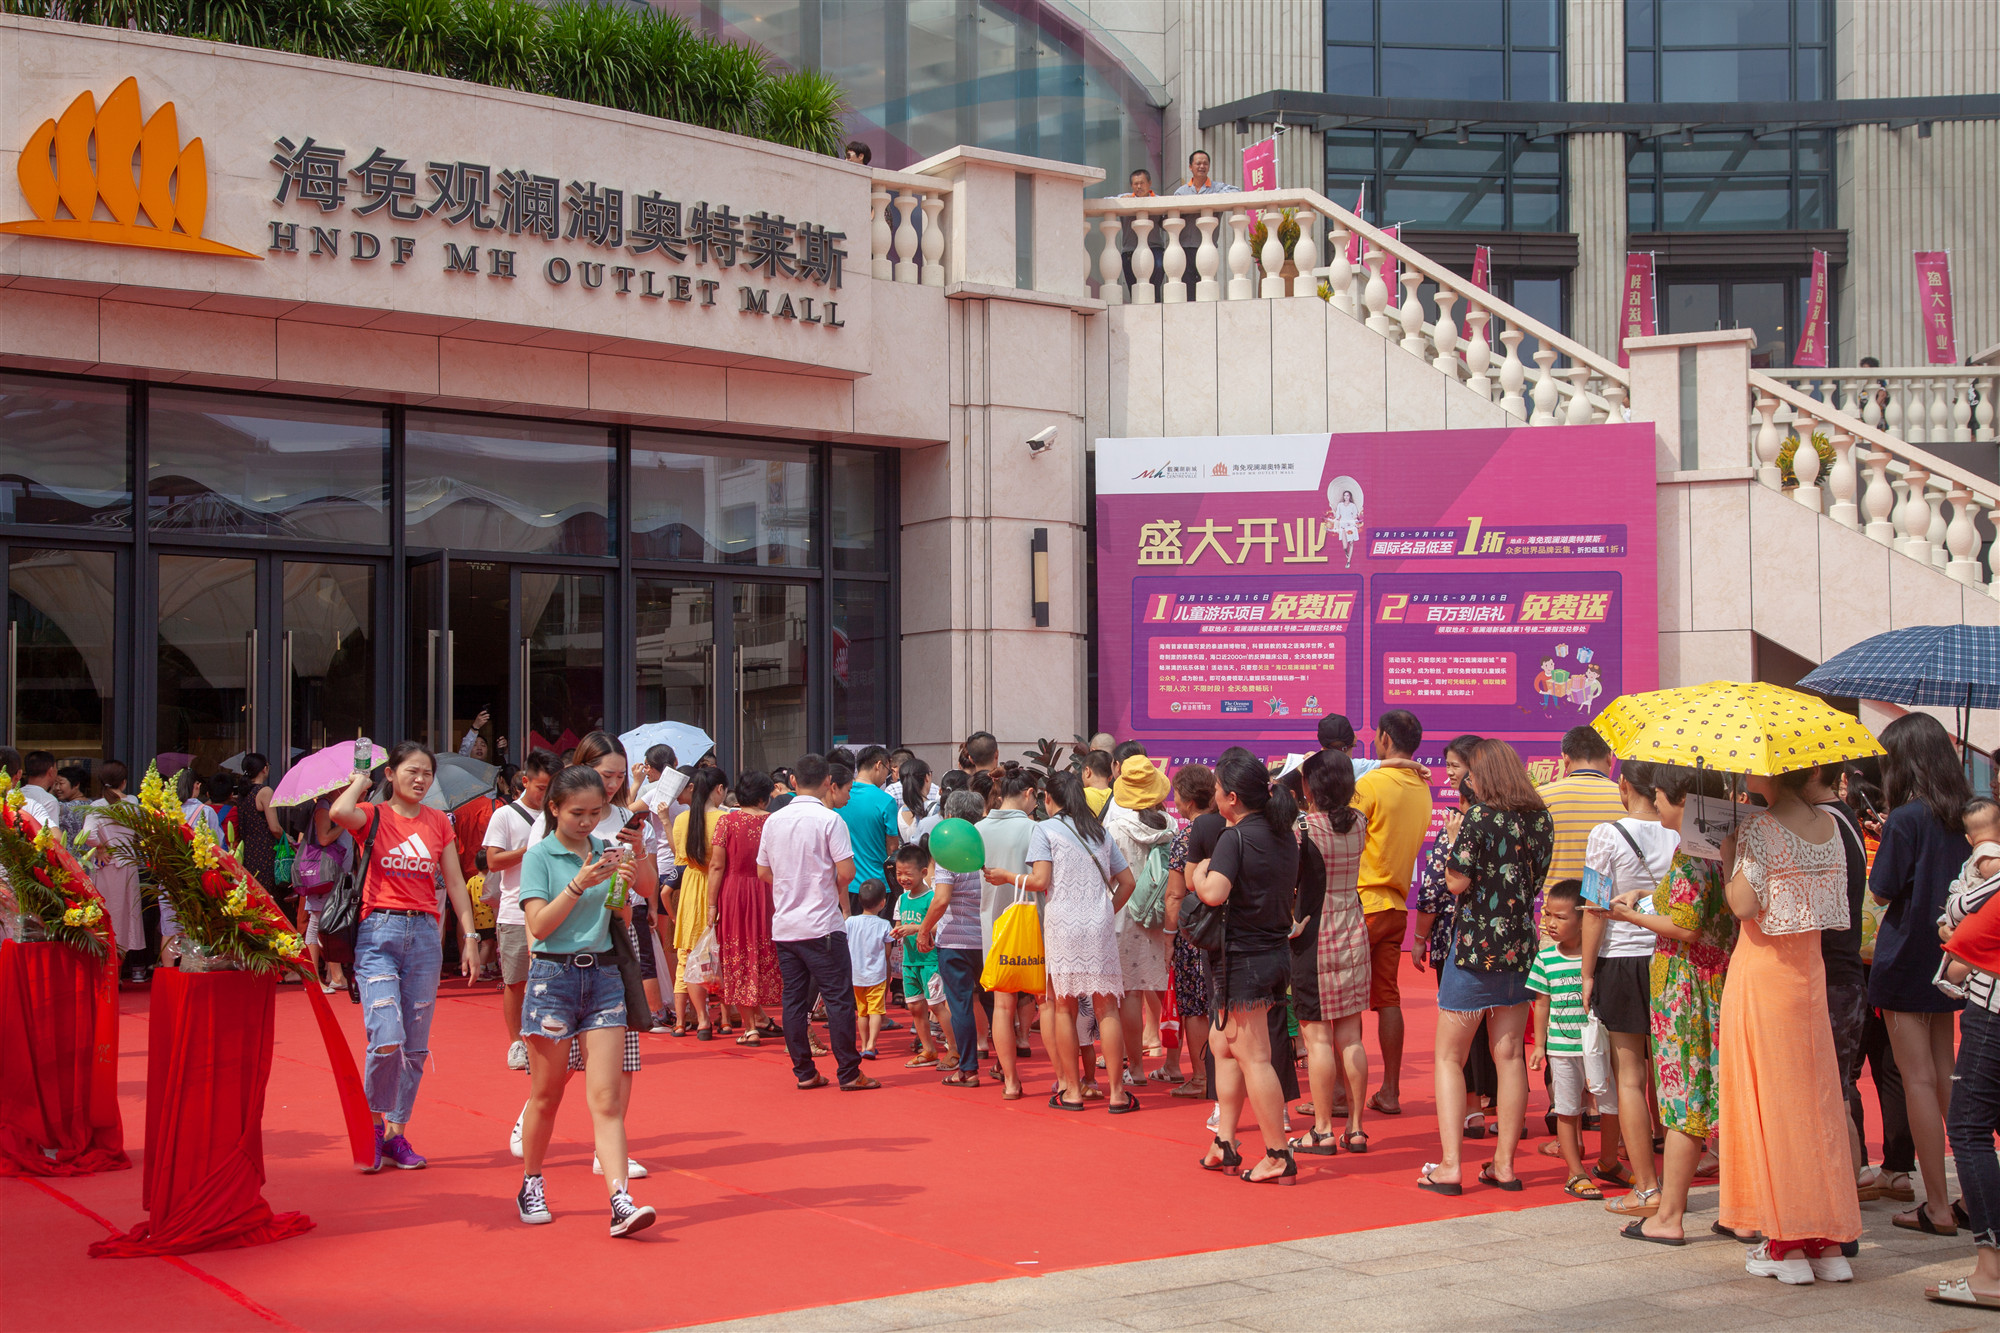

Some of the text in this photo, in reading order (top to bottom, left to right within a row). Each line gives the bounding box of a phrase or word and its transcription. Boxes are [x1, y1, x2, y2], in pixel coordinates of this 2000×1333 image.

[271, 136, 849, 290] 海免观澜湖奥特莱斯
[269, 220, 846, 329] HNDF MH OUTLET MALL
[1232, 462, 1295, 472] 海免观澜湖奥特莱斯
[1137, 518, 1329, 566] 盛大开业
[1373, 540, 1455, 555] 国际名品低至
[1152, 595, 1169, 620] 1
[1173, 593, 1353, 622] 儿童游乐项目 免费玩
[1426, 593, 1609, 622] 百万到店礼 免费送
[380, 854, 435, 874] adidas
[999, 954, 1046, 966] Balabala
